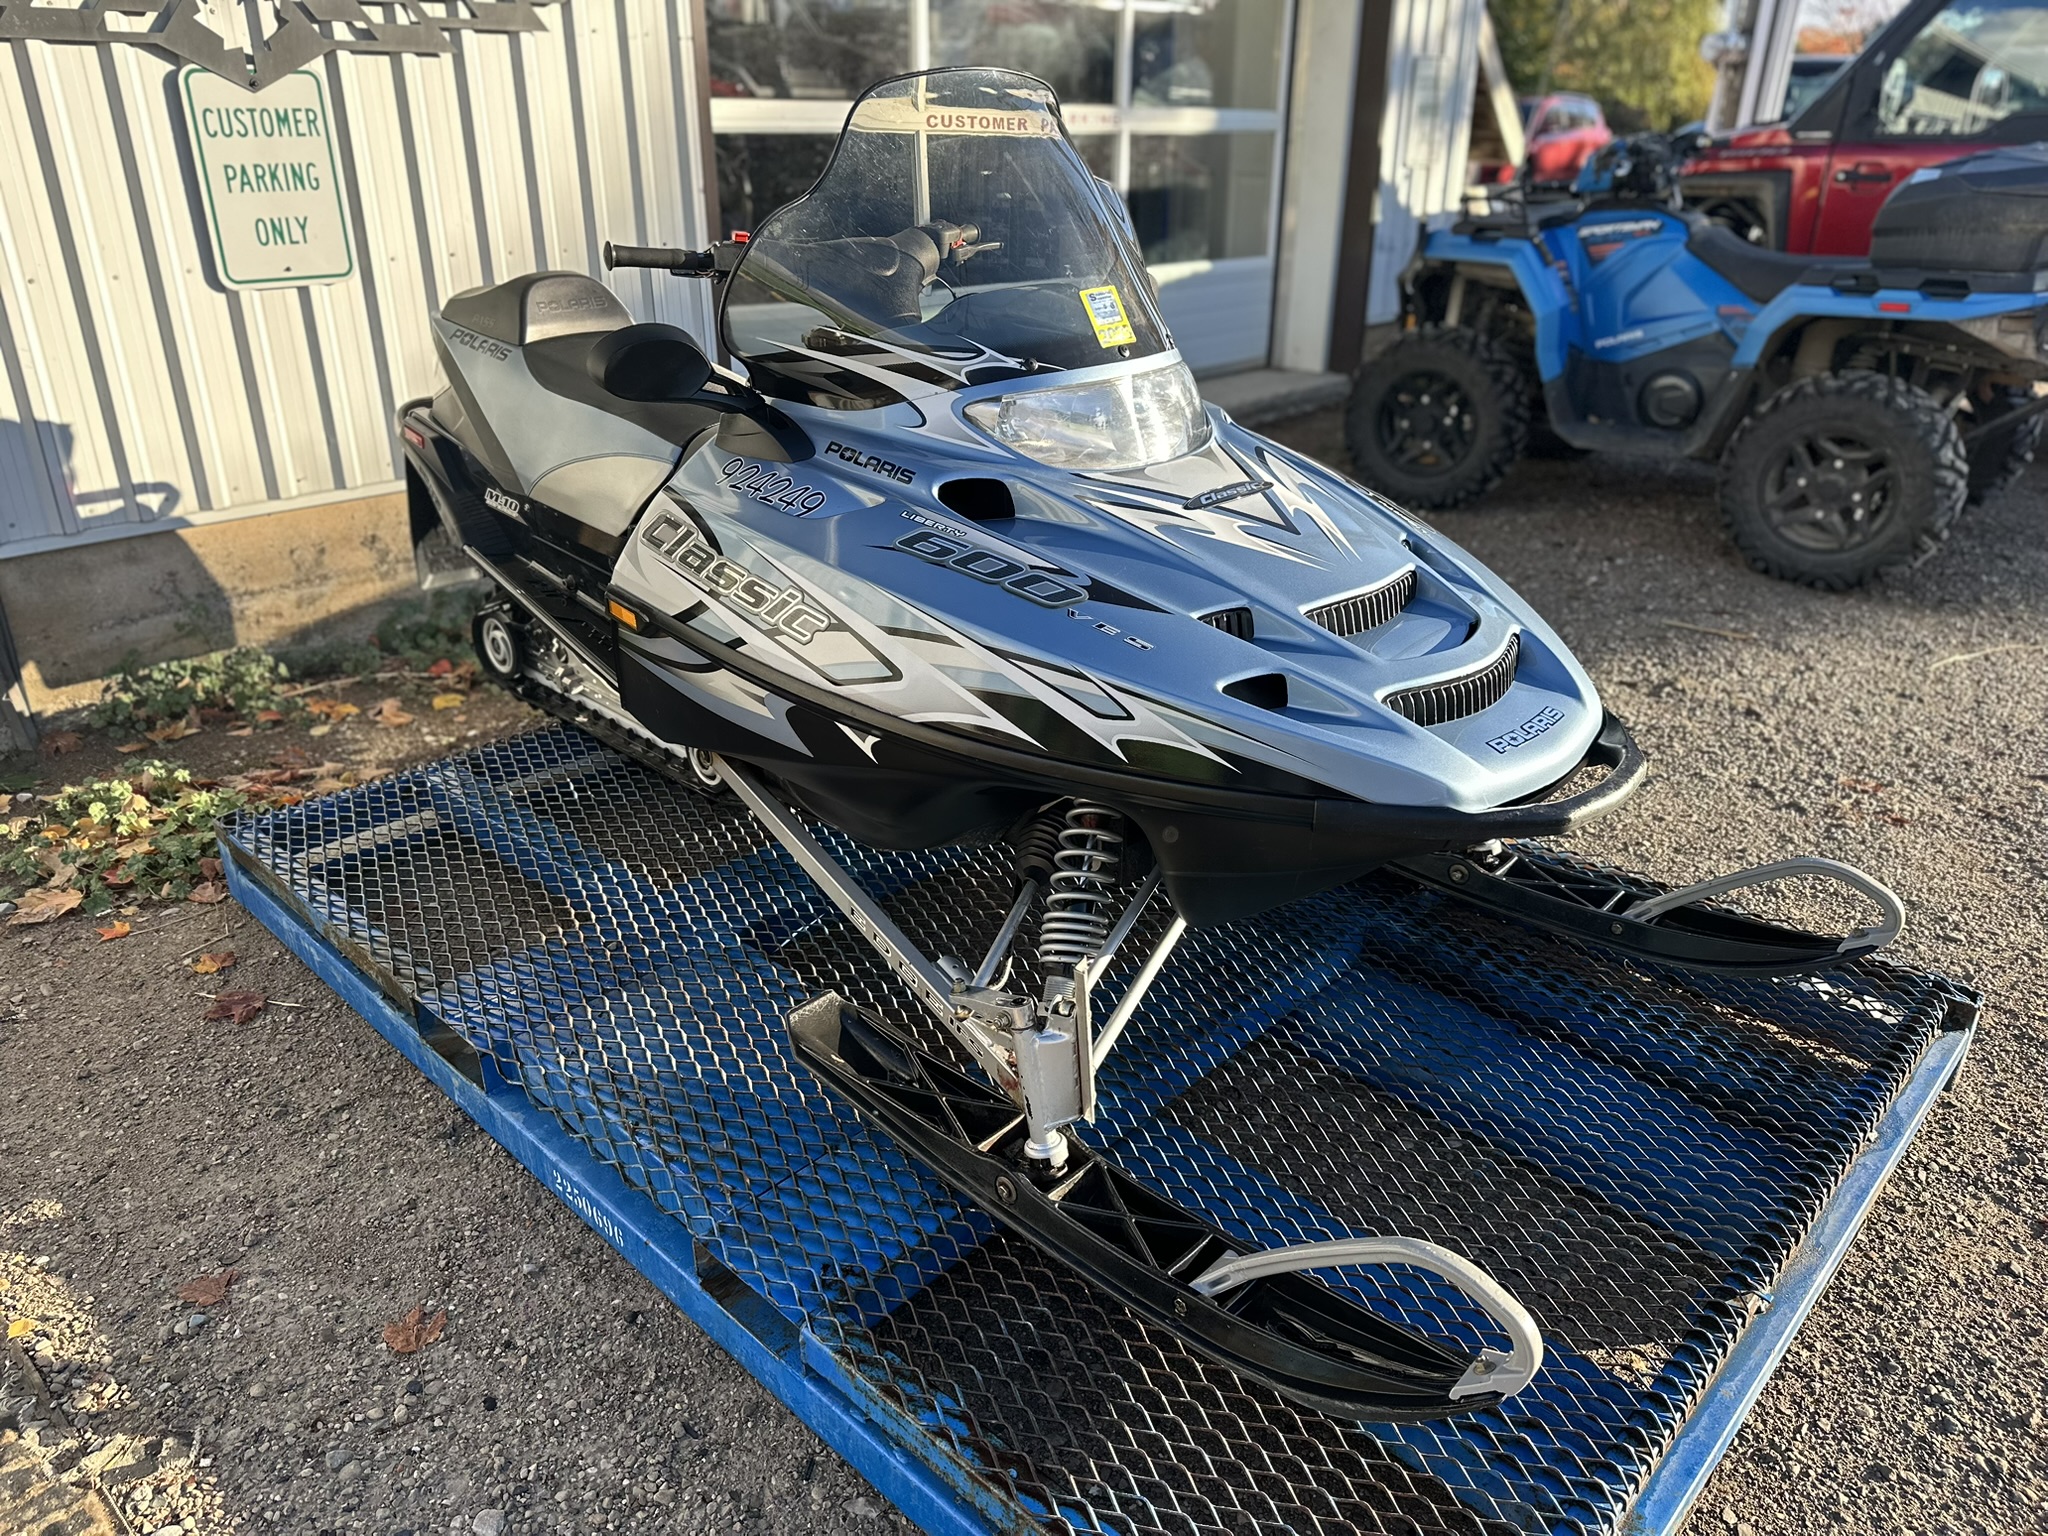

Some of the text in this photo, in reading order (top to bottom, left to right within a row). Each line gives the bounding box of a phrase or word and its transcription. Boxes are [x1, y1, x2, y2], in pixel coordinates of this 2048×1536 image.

[202, 107, 321, 138] CUSTOMER
[926, 114, 1028, 131] CUSTOMER
[223, 162, 320, 194] PARKING
[255, 216, 308, 246] ONLY
[536, 297, 608, 314] POLARIS
[449, 328, 512, 362] POLARIS
[824, 440, 917, 486] POLARIS
[484, 487, 520, 513] M-10
[715, 456, 827, 518] 924249
[1200, 480, 1261, 505] Classic
[900, 510, 967, 537] LIBERTY
[640, 510, 830, 645] Classic
[894, 528, 1090, 607] 600
[1066, 607, 1155, 651] VES
[1485, 705, 1565, 754] POLARIS
[553, 1169, 624, 1247] 2250696
